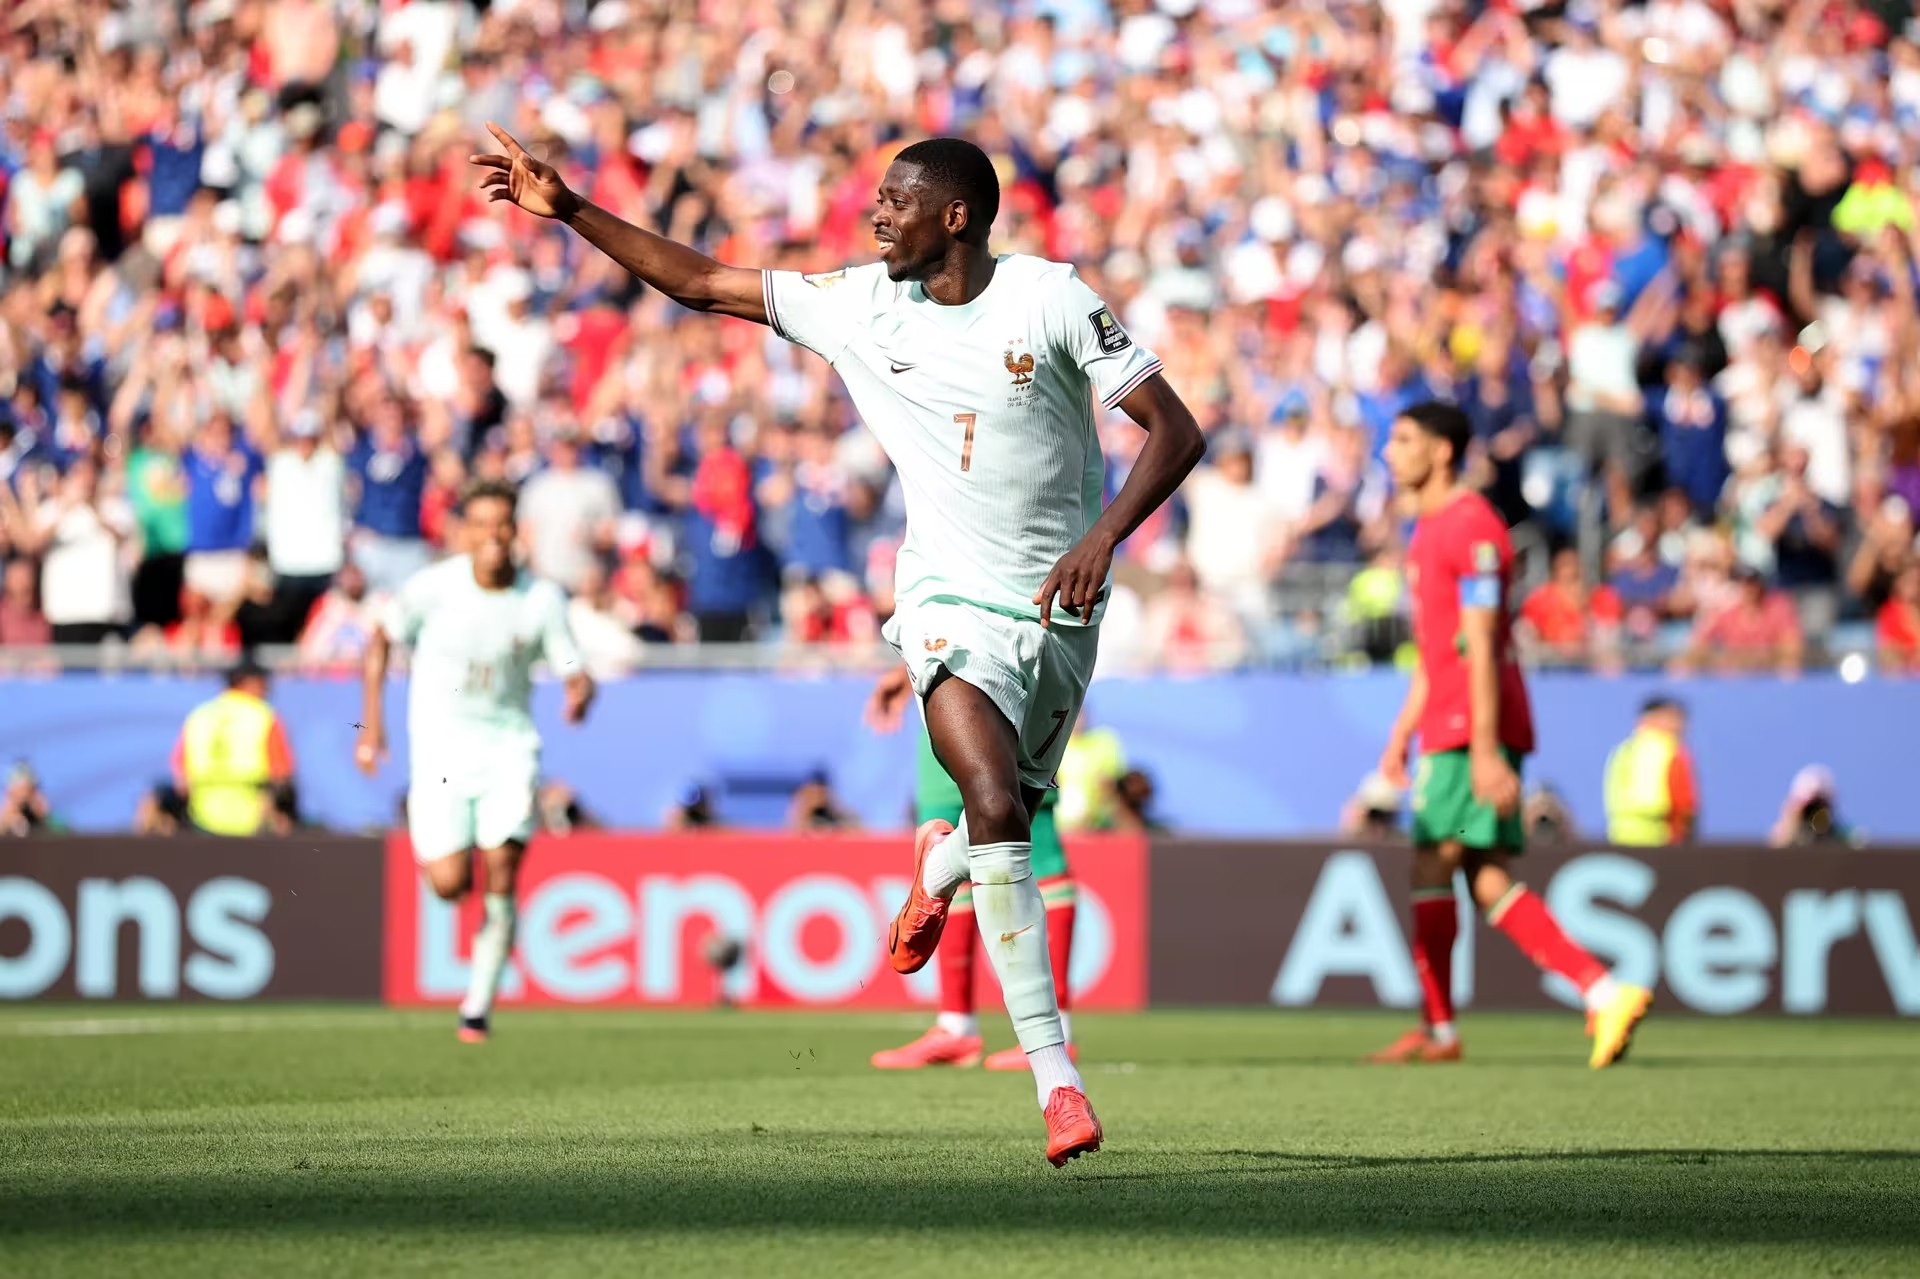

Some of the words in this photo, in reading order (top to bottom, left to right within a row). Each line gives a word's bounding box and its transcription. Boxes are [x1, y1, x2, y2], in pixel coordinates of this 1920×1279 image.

[953, 413, 976, 472] 7
[1031, 708, 1070, 760] 7
[0, 875, 275, 999] ons
